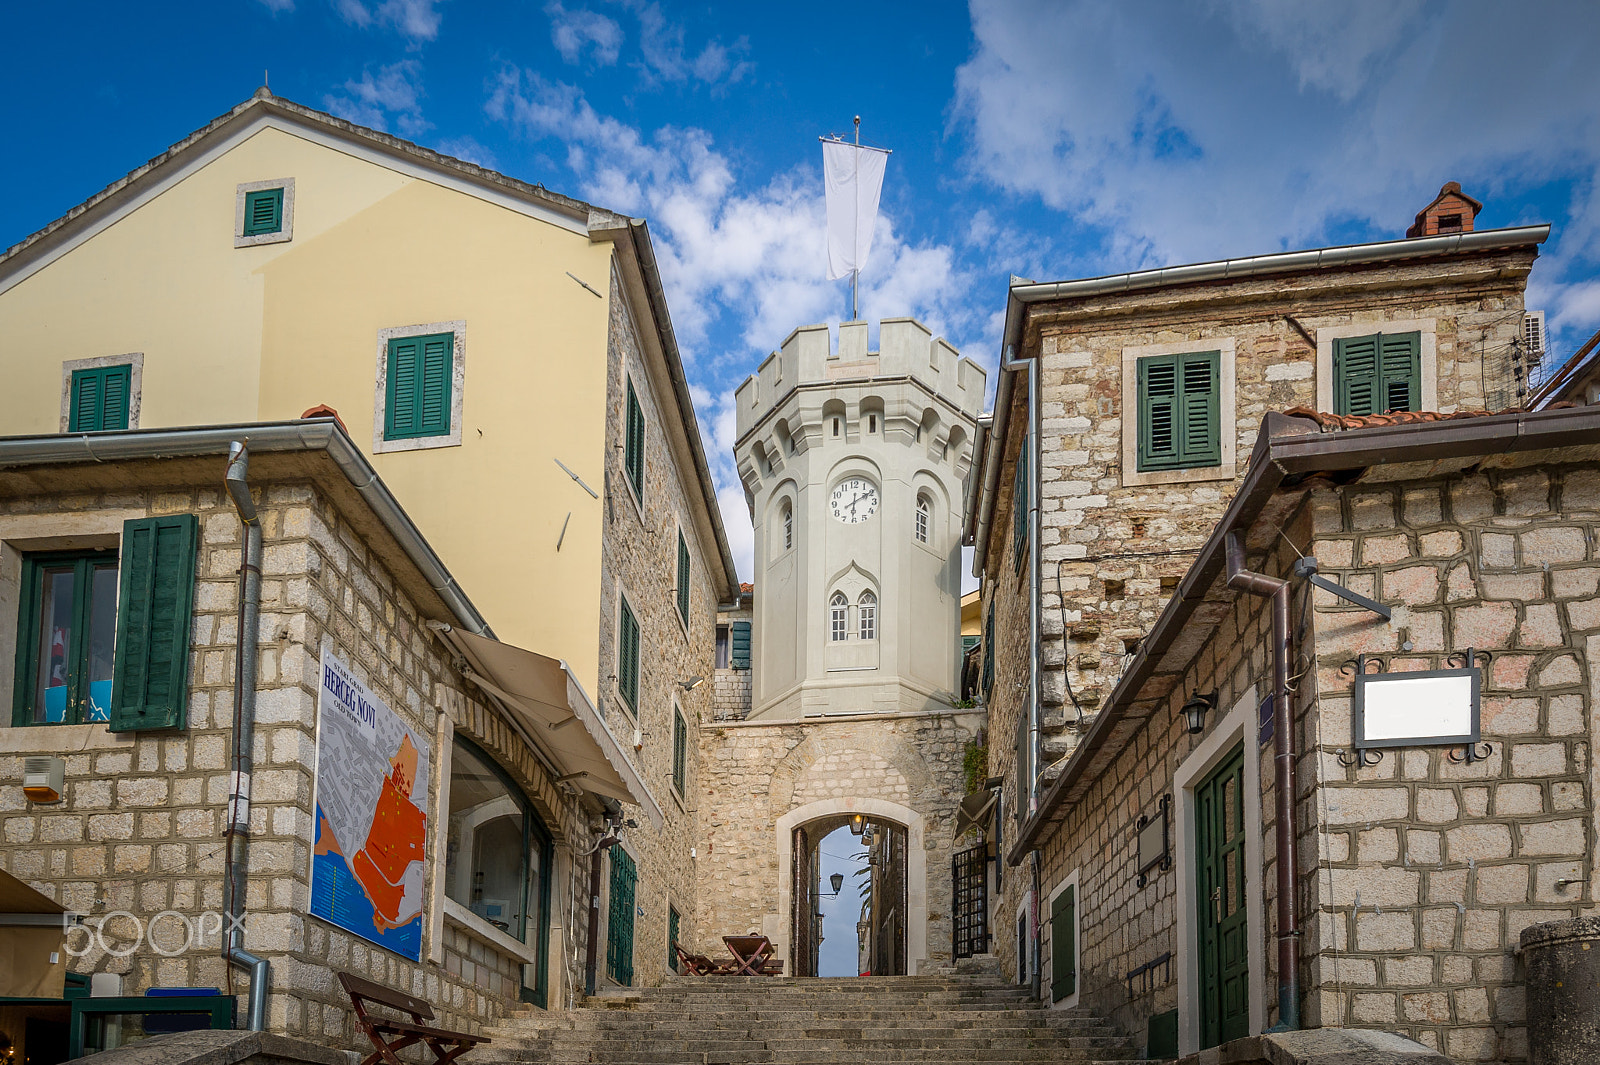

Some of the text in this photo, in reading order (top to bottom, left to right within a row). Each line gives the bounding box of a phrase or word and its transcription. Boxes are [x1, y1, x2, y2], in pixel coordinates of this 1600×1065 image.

[833, 491, 841, 499] 10
[850, 480, 859, 489] 12
[333, 662, 364, 694] STARI GRAD
[324, 664, 376, 729] HERCEG NOVI
[333, 700, 362, 727] OLD TOWN
